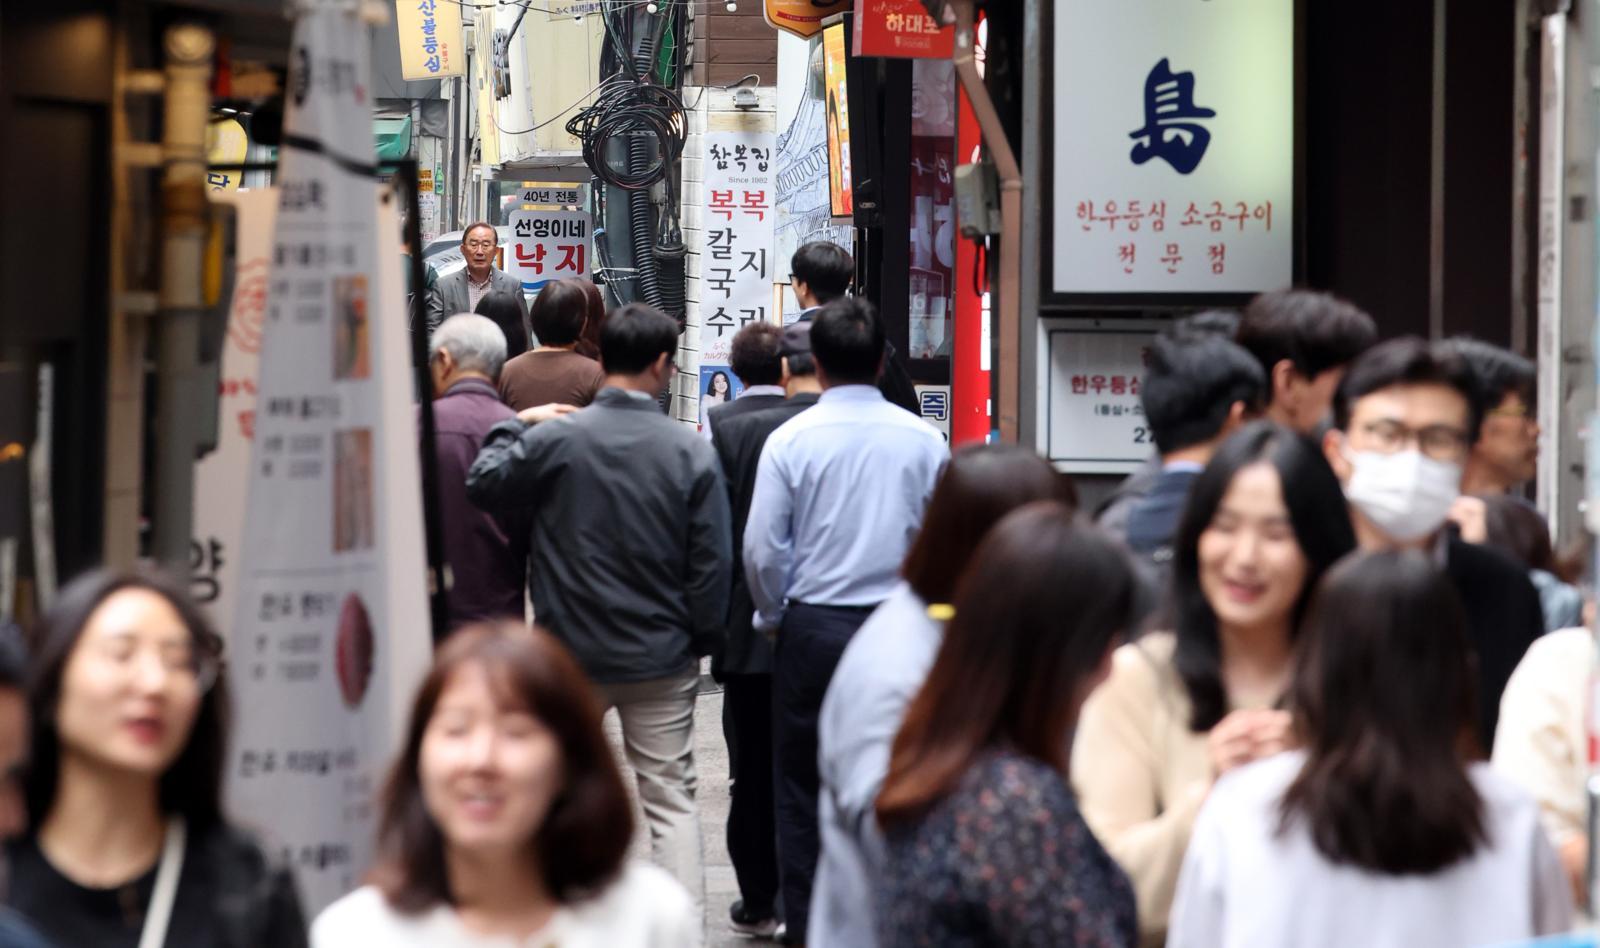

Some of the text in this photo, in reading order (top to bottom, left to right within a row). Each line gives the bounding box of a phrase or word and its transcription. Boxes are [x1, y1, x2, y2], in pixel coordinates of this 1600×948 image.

[1127, 56, 1217, 175] 島
[710, 143, 770, 173] 참복집
[728, 176, 749, 184] Since
[523, 190, 578, 204] 40년 전통
[514, 218, 586, 239] 선영이네
[1076, 199, 1272, 232] 한우등심 소금구이
[515, 242, 585, 275] 낙지
